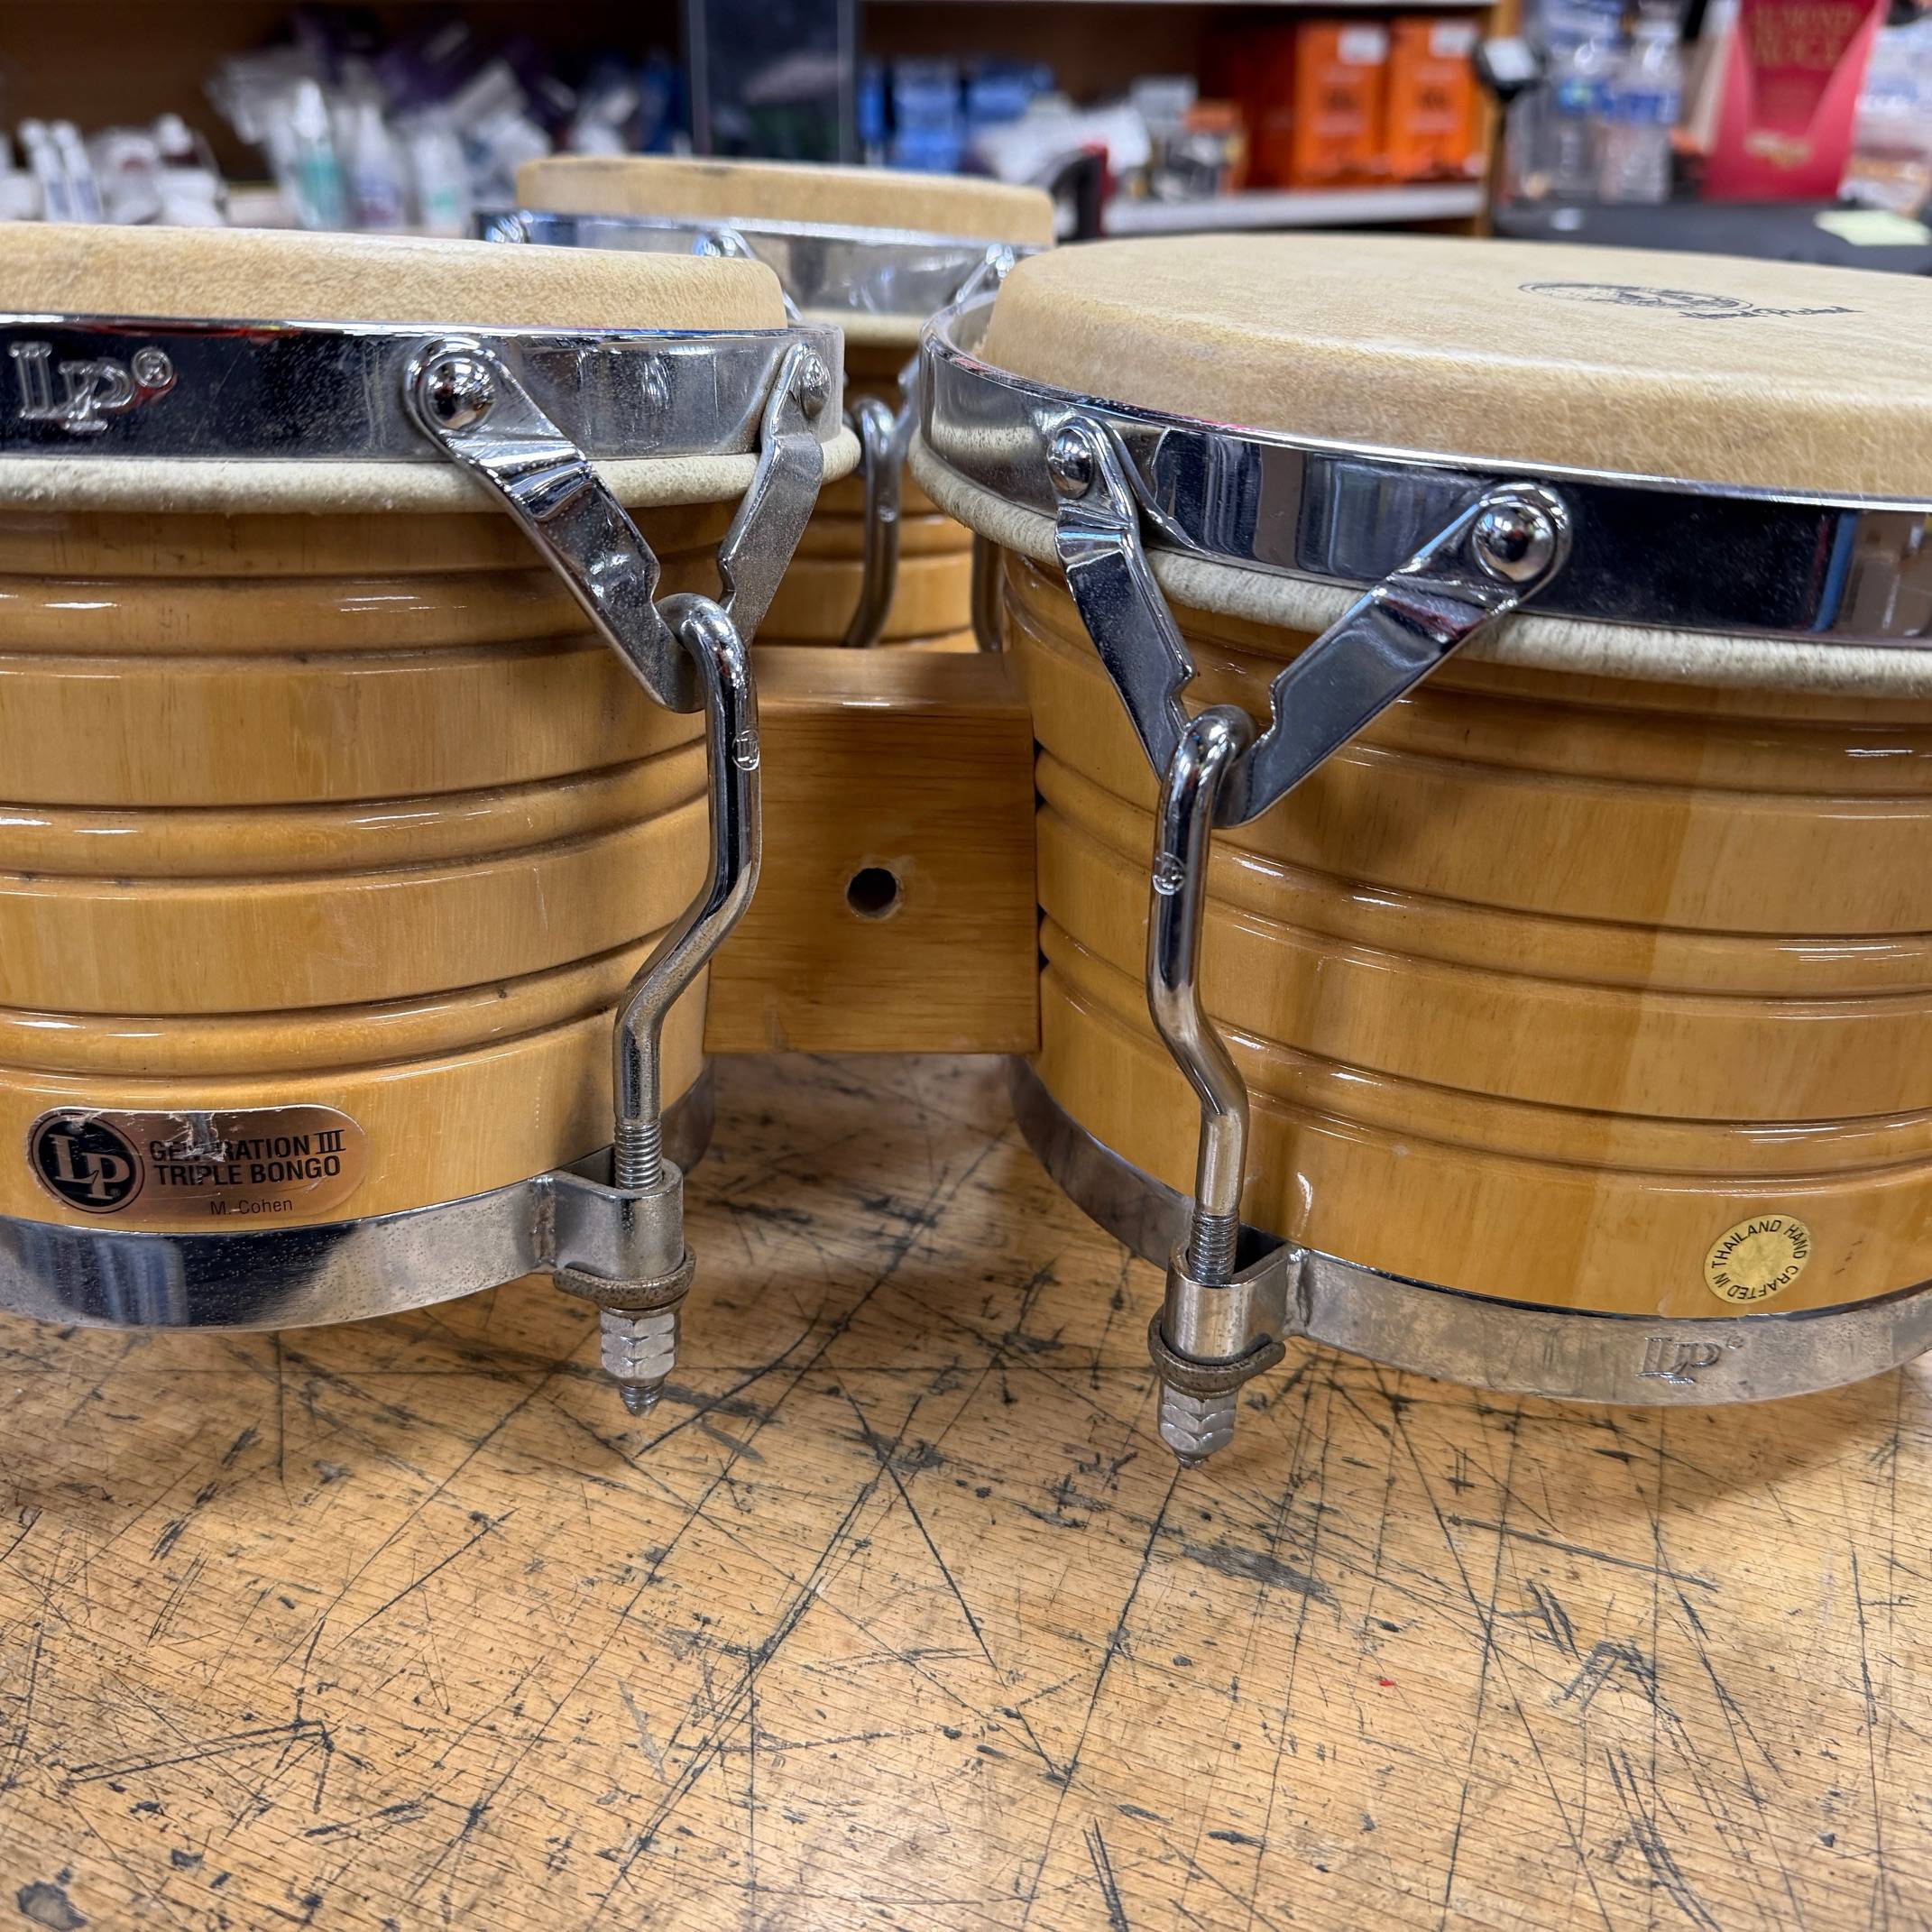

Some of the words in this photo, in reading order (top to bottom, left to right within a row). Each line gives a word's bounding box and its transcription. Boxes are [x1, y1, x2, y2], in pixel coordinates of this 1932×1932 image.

[315, 1129, 346, 1154] III
[48, 1134, 131, 1201] LP
[154, 1163, 244, 1185] TRIPLE
[252, 1155, 341, 1183] BONGO
[238, 1199, 292, 1213] Cohen
[1711, 1219, 1782, 1269] THAILAND
[1783, 1224, 1808, 1259] HAND
[1713, 1273, 1731, 1288] IN
[1726, 1265, 1799, 1300] CRAFTED
